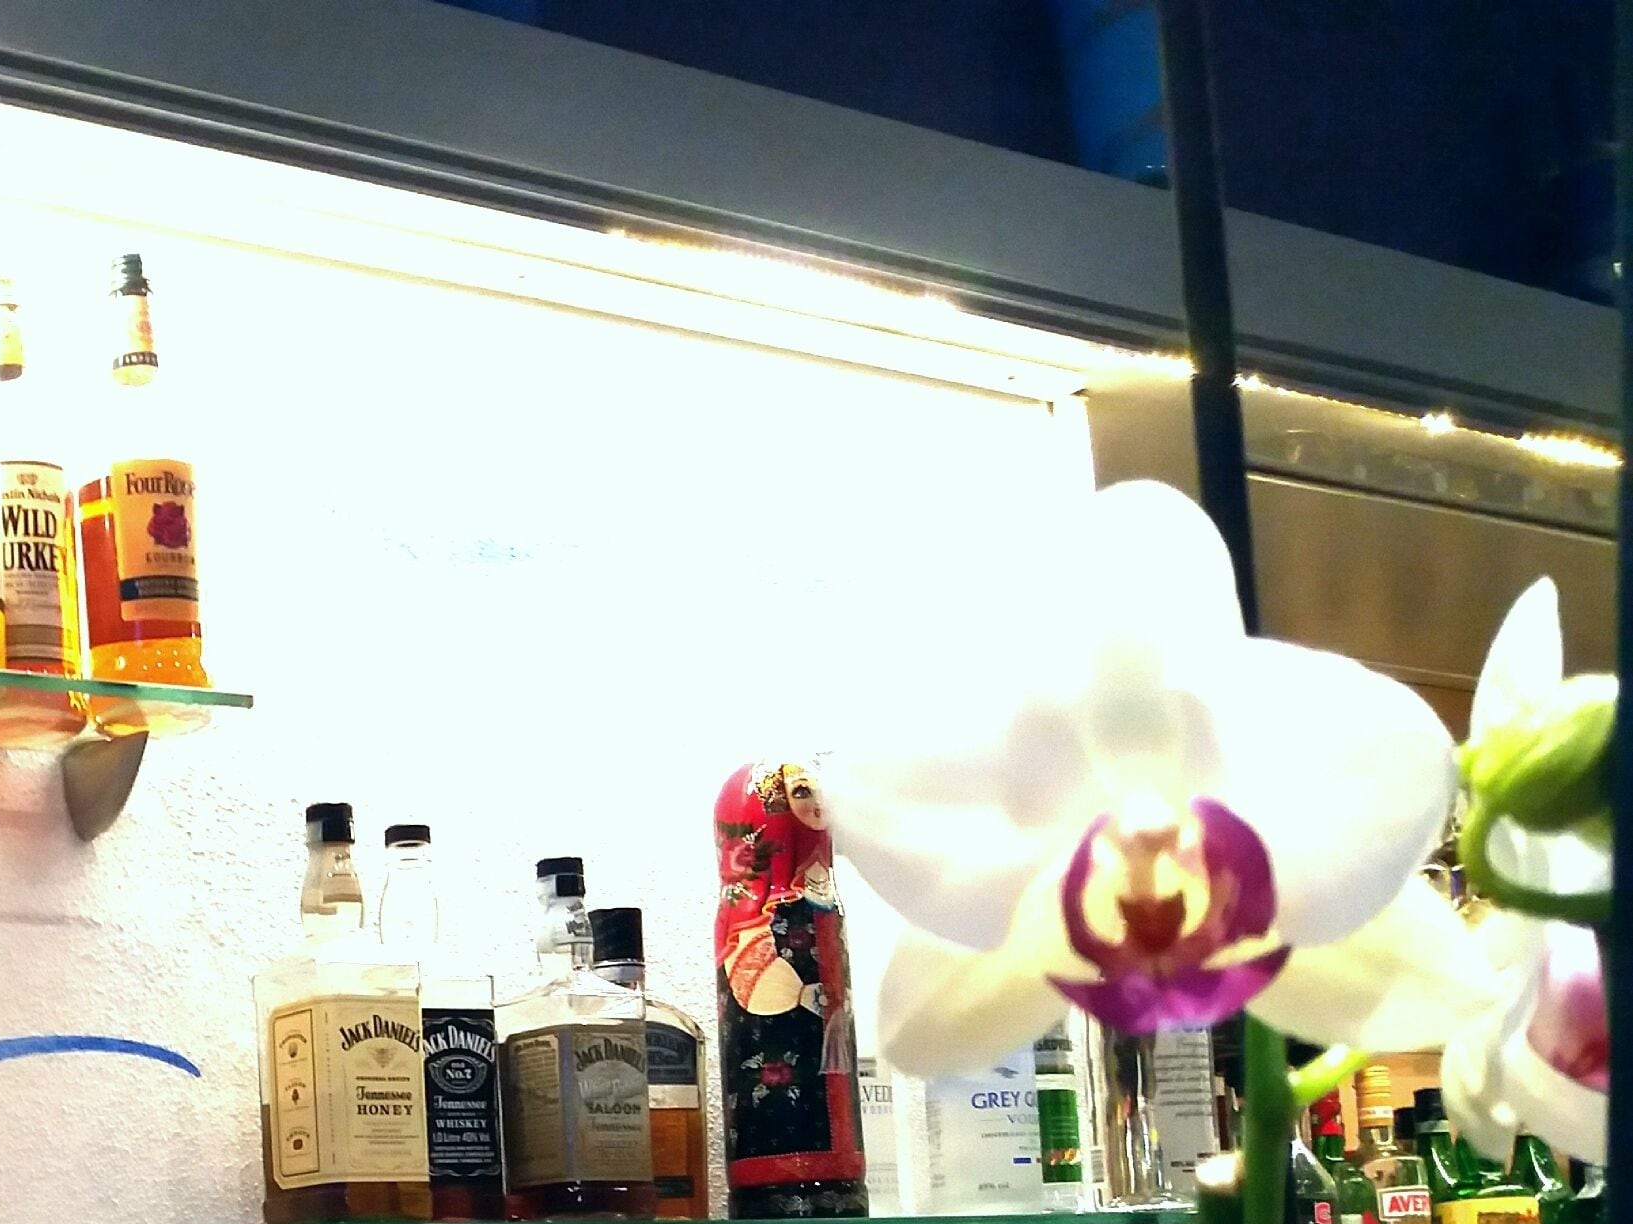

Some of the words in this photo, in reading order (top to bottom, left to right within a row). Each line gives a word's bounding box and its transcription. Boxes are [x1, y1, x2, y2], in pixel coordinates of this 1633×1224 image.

[1, 504, 57, 538] WILD
[2, 541, 59, 573] URKE
[339, 1021, 373, 1051] JACK
[423, 1032, 449, 1061] ACK
[356, 1104, 414, 1116] HONEY
[971, 1090, 1020, 1109] GREY
[435, 1119, 487, 1128] WHISKEY
